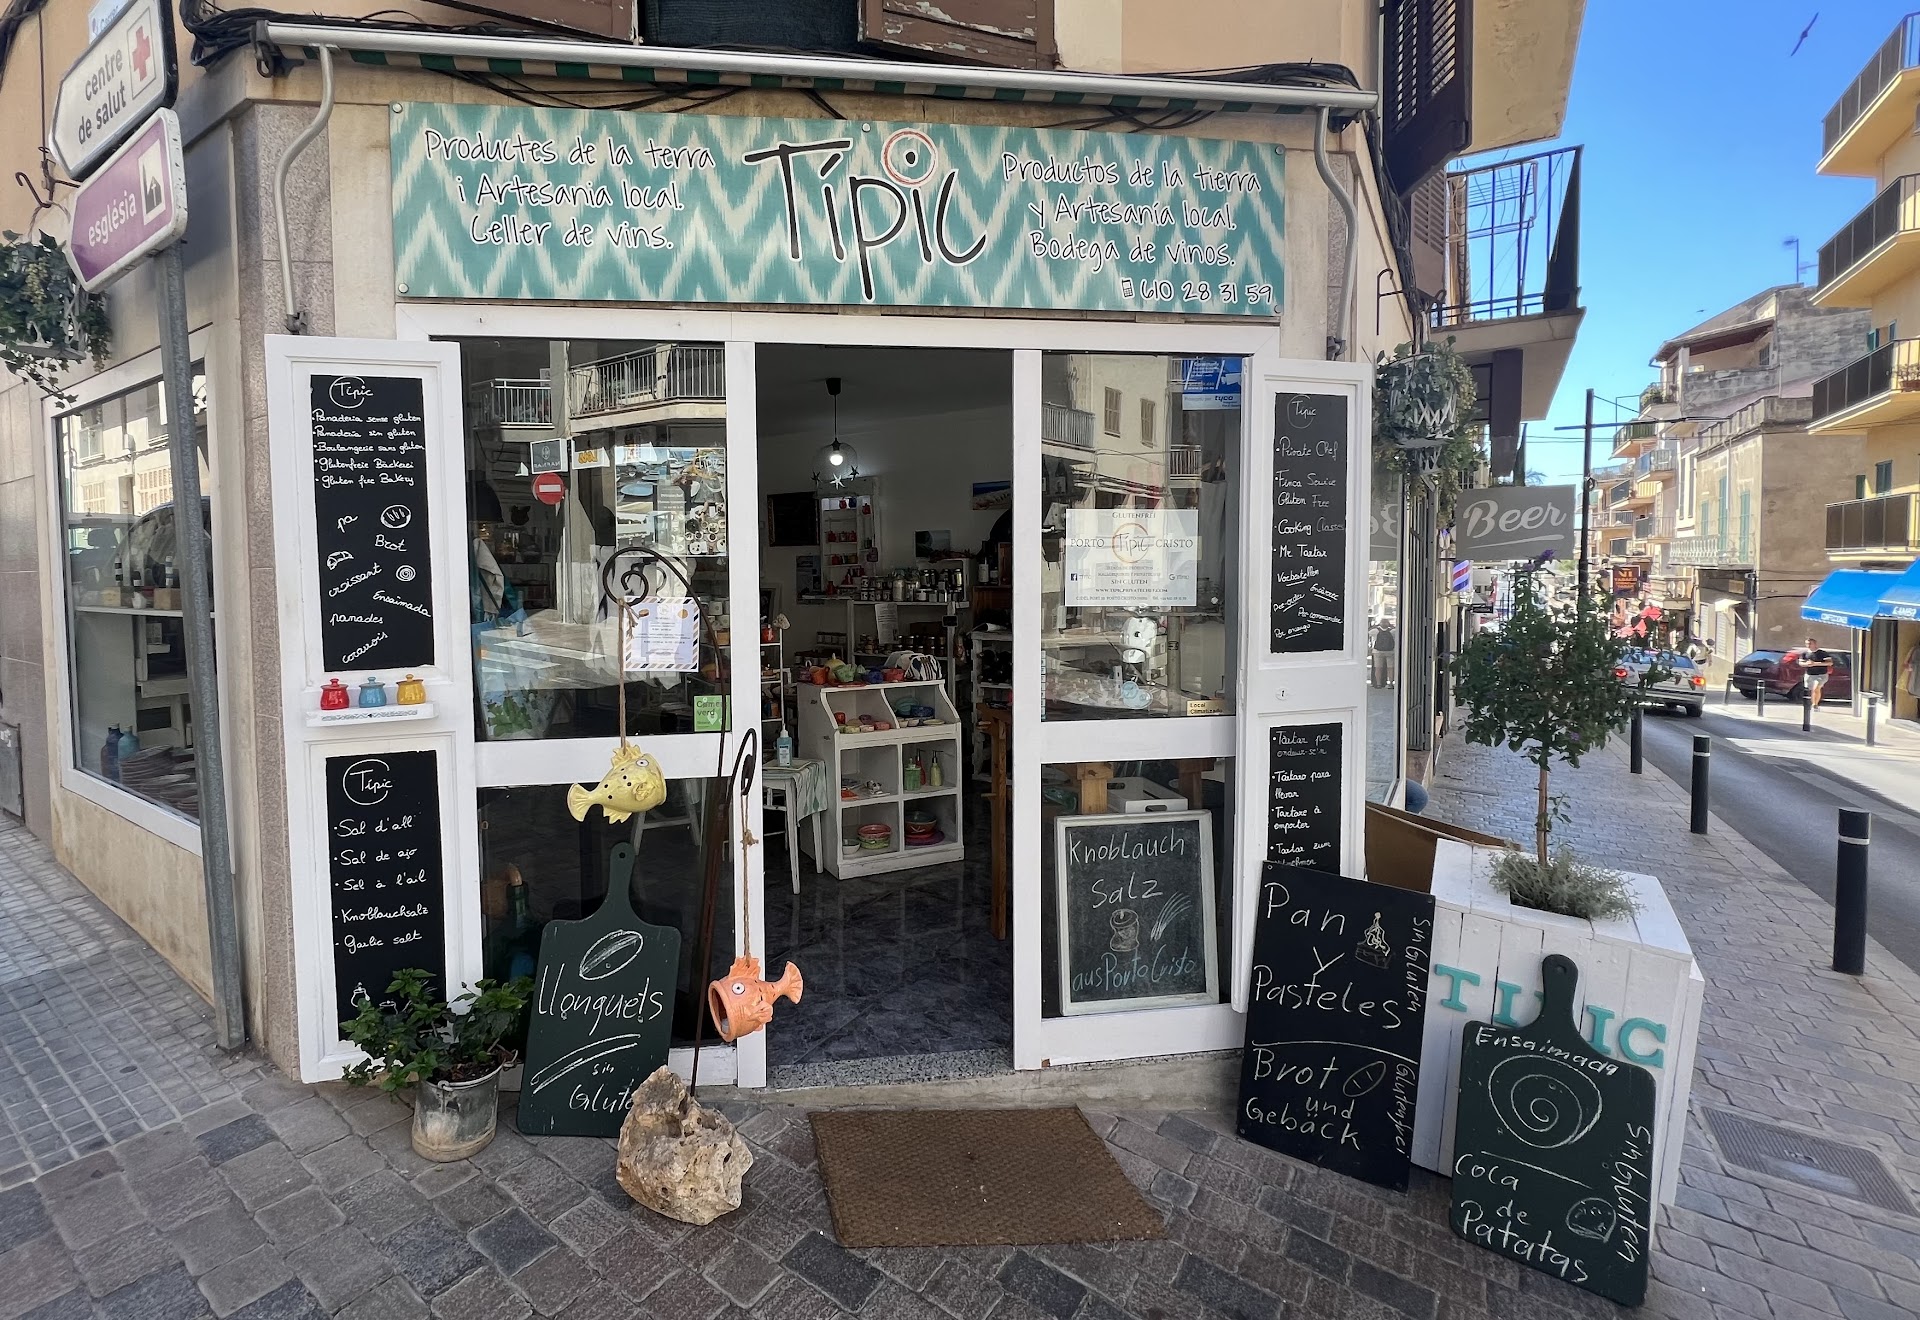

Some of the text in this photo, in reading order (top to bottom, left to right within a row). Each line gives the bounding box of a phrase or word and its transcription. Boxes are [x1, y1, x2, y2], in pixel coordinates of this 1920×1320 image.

[85, 48, 123, 102] centre
[78, 80, 126, 145] de salut
[424, 129, 715, 170] Productes de la terra
[1002, 152, 1261, 193] Productos de la tierra
[456, 174, 684, 210] i Artesania local.
[88, 189, 137, 247] església
[744, 130, 987, 301] Típic
[1030, 193, 1237, 230] y Artesanía local.
[470, 215, 674, 249] Celler de vins.
[1030, 231, 1236, 272] Bodega de vinos.
[1141, 280, 1273, 304] 610 28 31 59
[1214, 395, 1234, 403] tyco
[387, 427, 416, 440] gluten
[393, 412, 421, 425] gluten
[1279, 436, 1339, 461] Private Chef
[321, 475, 354, 489] Gluten
[358, 474, 376, 488] free
[1276, 469, 1303, 488] Finca
[1277, 491, 1307, 506] Gluten
[336, 514, 359, 533] pa
[1278, 519, 1312, 536] Cooking
[1463, 499, 1568, 540] Beer
[374, 533, 407, 551] Brot
[1070, 538, 1105, 548] PORTO
[1155, 538, 1194, 548] CRISTO
[1296, 543, 1328, 557] Tartar
[328, 562, 382, 597] croissant
[1275, 787, 1300, 800] llevar
[1310, 770, 1332, 783] para
[336, 818, 366, 838] Sal
[340, 848, 418, 866] Sal de ajo
[1069, 827, 1185, 866] Knoblauch
[343, 878, 365, 891] Sel
[1091, 871, 1164, 909] Salz
[340, 902, 429, 924] Knoblauchsalz
[1264, 881, 1346, 936] Pan
[344, 929, 423, 955] Garlic salt
[1072, 943, 1196, 992] aus Porto Cristo
[1252, 963, 1402, 1030] Pasteles
[1434, 962, 1668, 1070] TIIC
[1474, 1025, 1619, 1077] Ensaimada
[1252, 1047, 1339, 1090] Brot
[568, 1078, 635, 1113] Glute
[1305, 1096, 1356, 1121] und
[1245, 1096, 1361, 1152] Gebäck
[1454, 1152, 1522, 1192] Coca
[1496, 1199, 1528, 1227] de
[1460, 1199, 1589, 1284] Patatas
